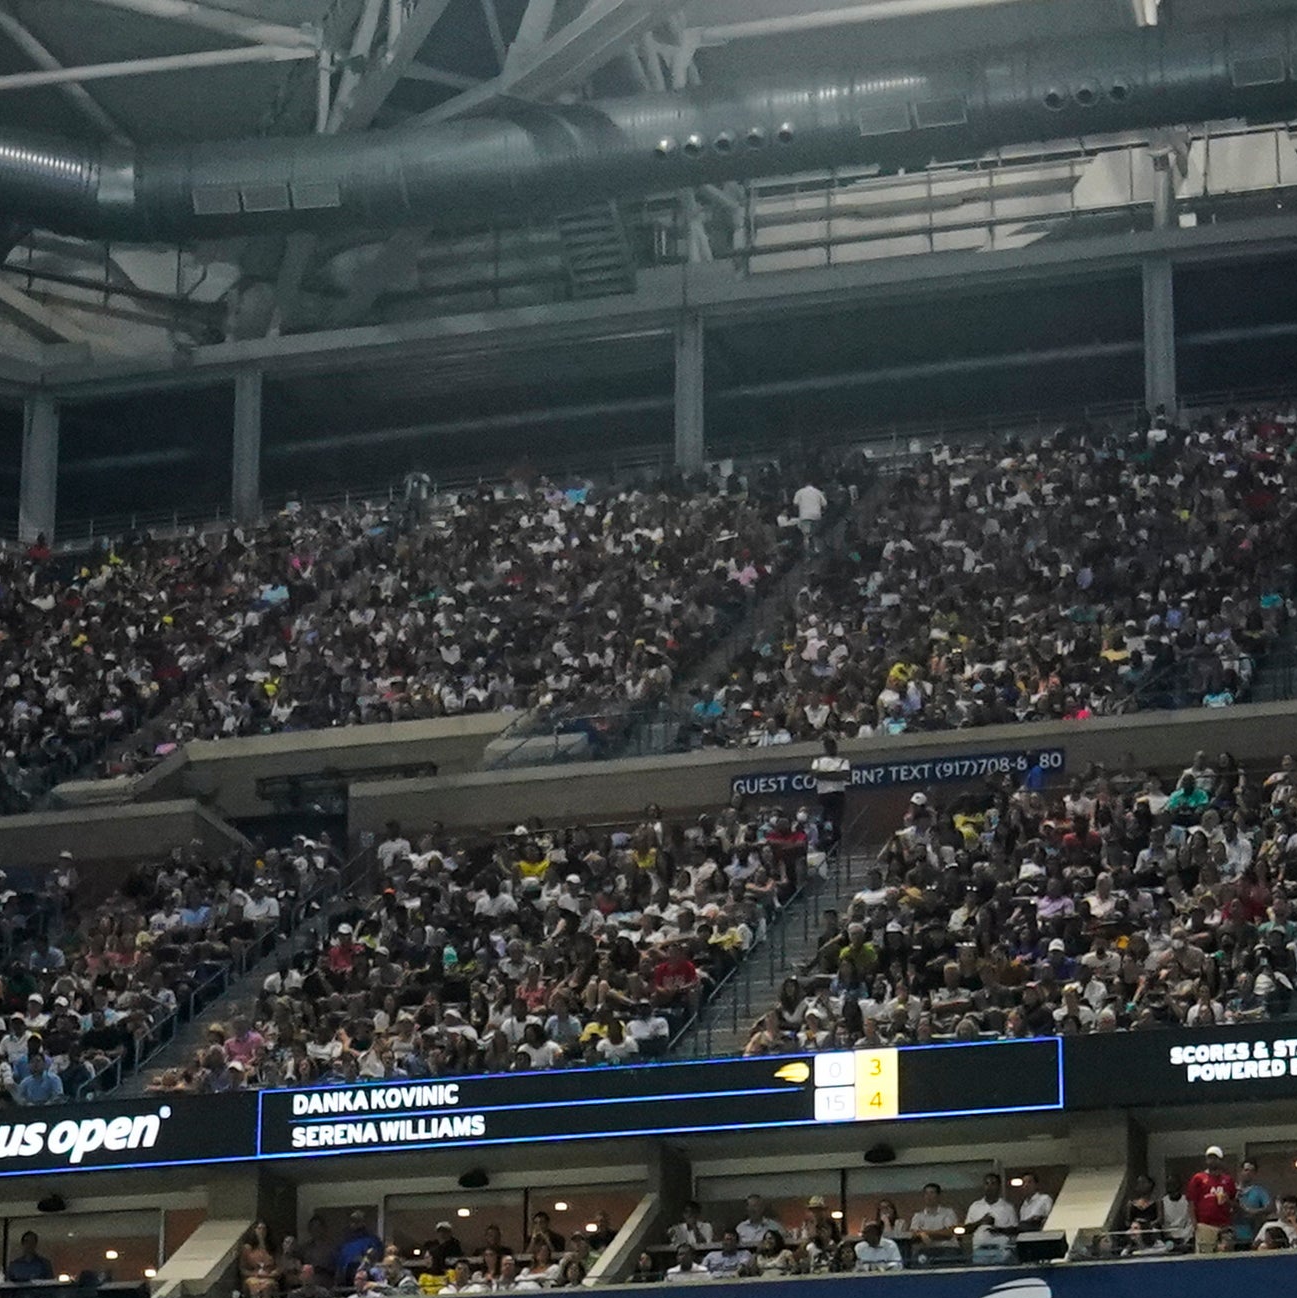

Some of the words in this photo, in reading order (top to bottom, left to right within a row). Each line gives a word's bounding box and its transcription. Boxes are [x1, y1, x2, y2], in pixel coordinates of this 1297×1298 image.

[733, 777, 785, 795] GUEST
[792, 768, 884, 792] CORN?
[890, 763, 930, 781] TEXT
[1170, 1042, 1250, 1065] SCORES
[1252, 1041, 1269, 1060] &
[869, 1058, 882, 1077] 3
[1187, 1059, 1287, 1083] POWERED
[292, 1090, 369, 1115] DANKA
[370, 1083, 459, 1110] KOVINIC
[869, 1091, 883, 1109] 4
[48, 1113, 161, 1164] open
[292, 1122, 379, 1148] SERENA
[379, 1115, 486, 1144] WILLIAMS
